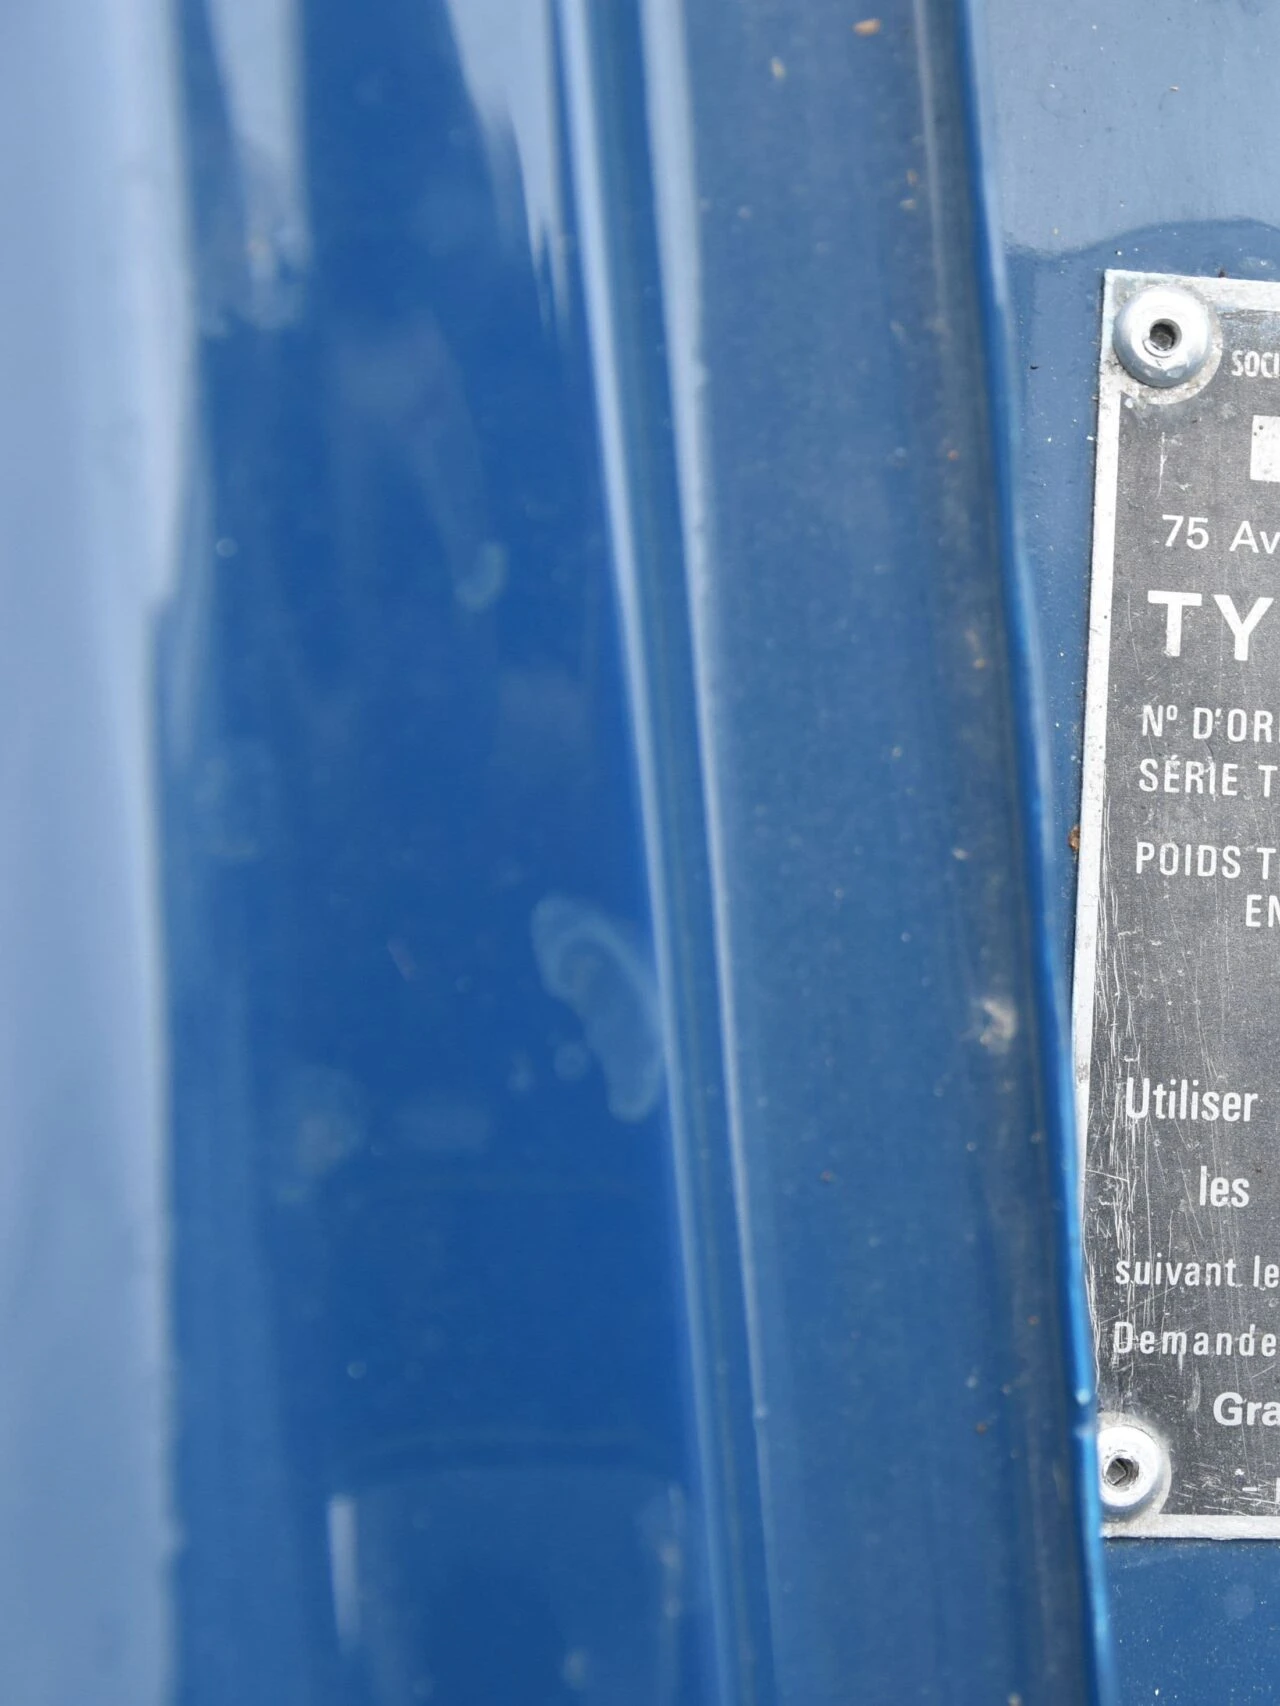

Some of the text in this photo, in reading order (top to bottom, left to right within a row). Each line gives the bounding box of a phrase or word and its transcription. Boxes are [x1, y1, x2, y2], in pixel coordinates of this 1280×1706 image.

[1162, 513, 1209, 549] 75
[1138, 753, 1238, 798] SÉRIE
[1136, 842, 1242, 879] POIDS
[1124, 1077, 1258, 1122] Utiliser
[1199, 1166, 1250, 1210] les
[1115, 1253, 1237, 1288] suivant
